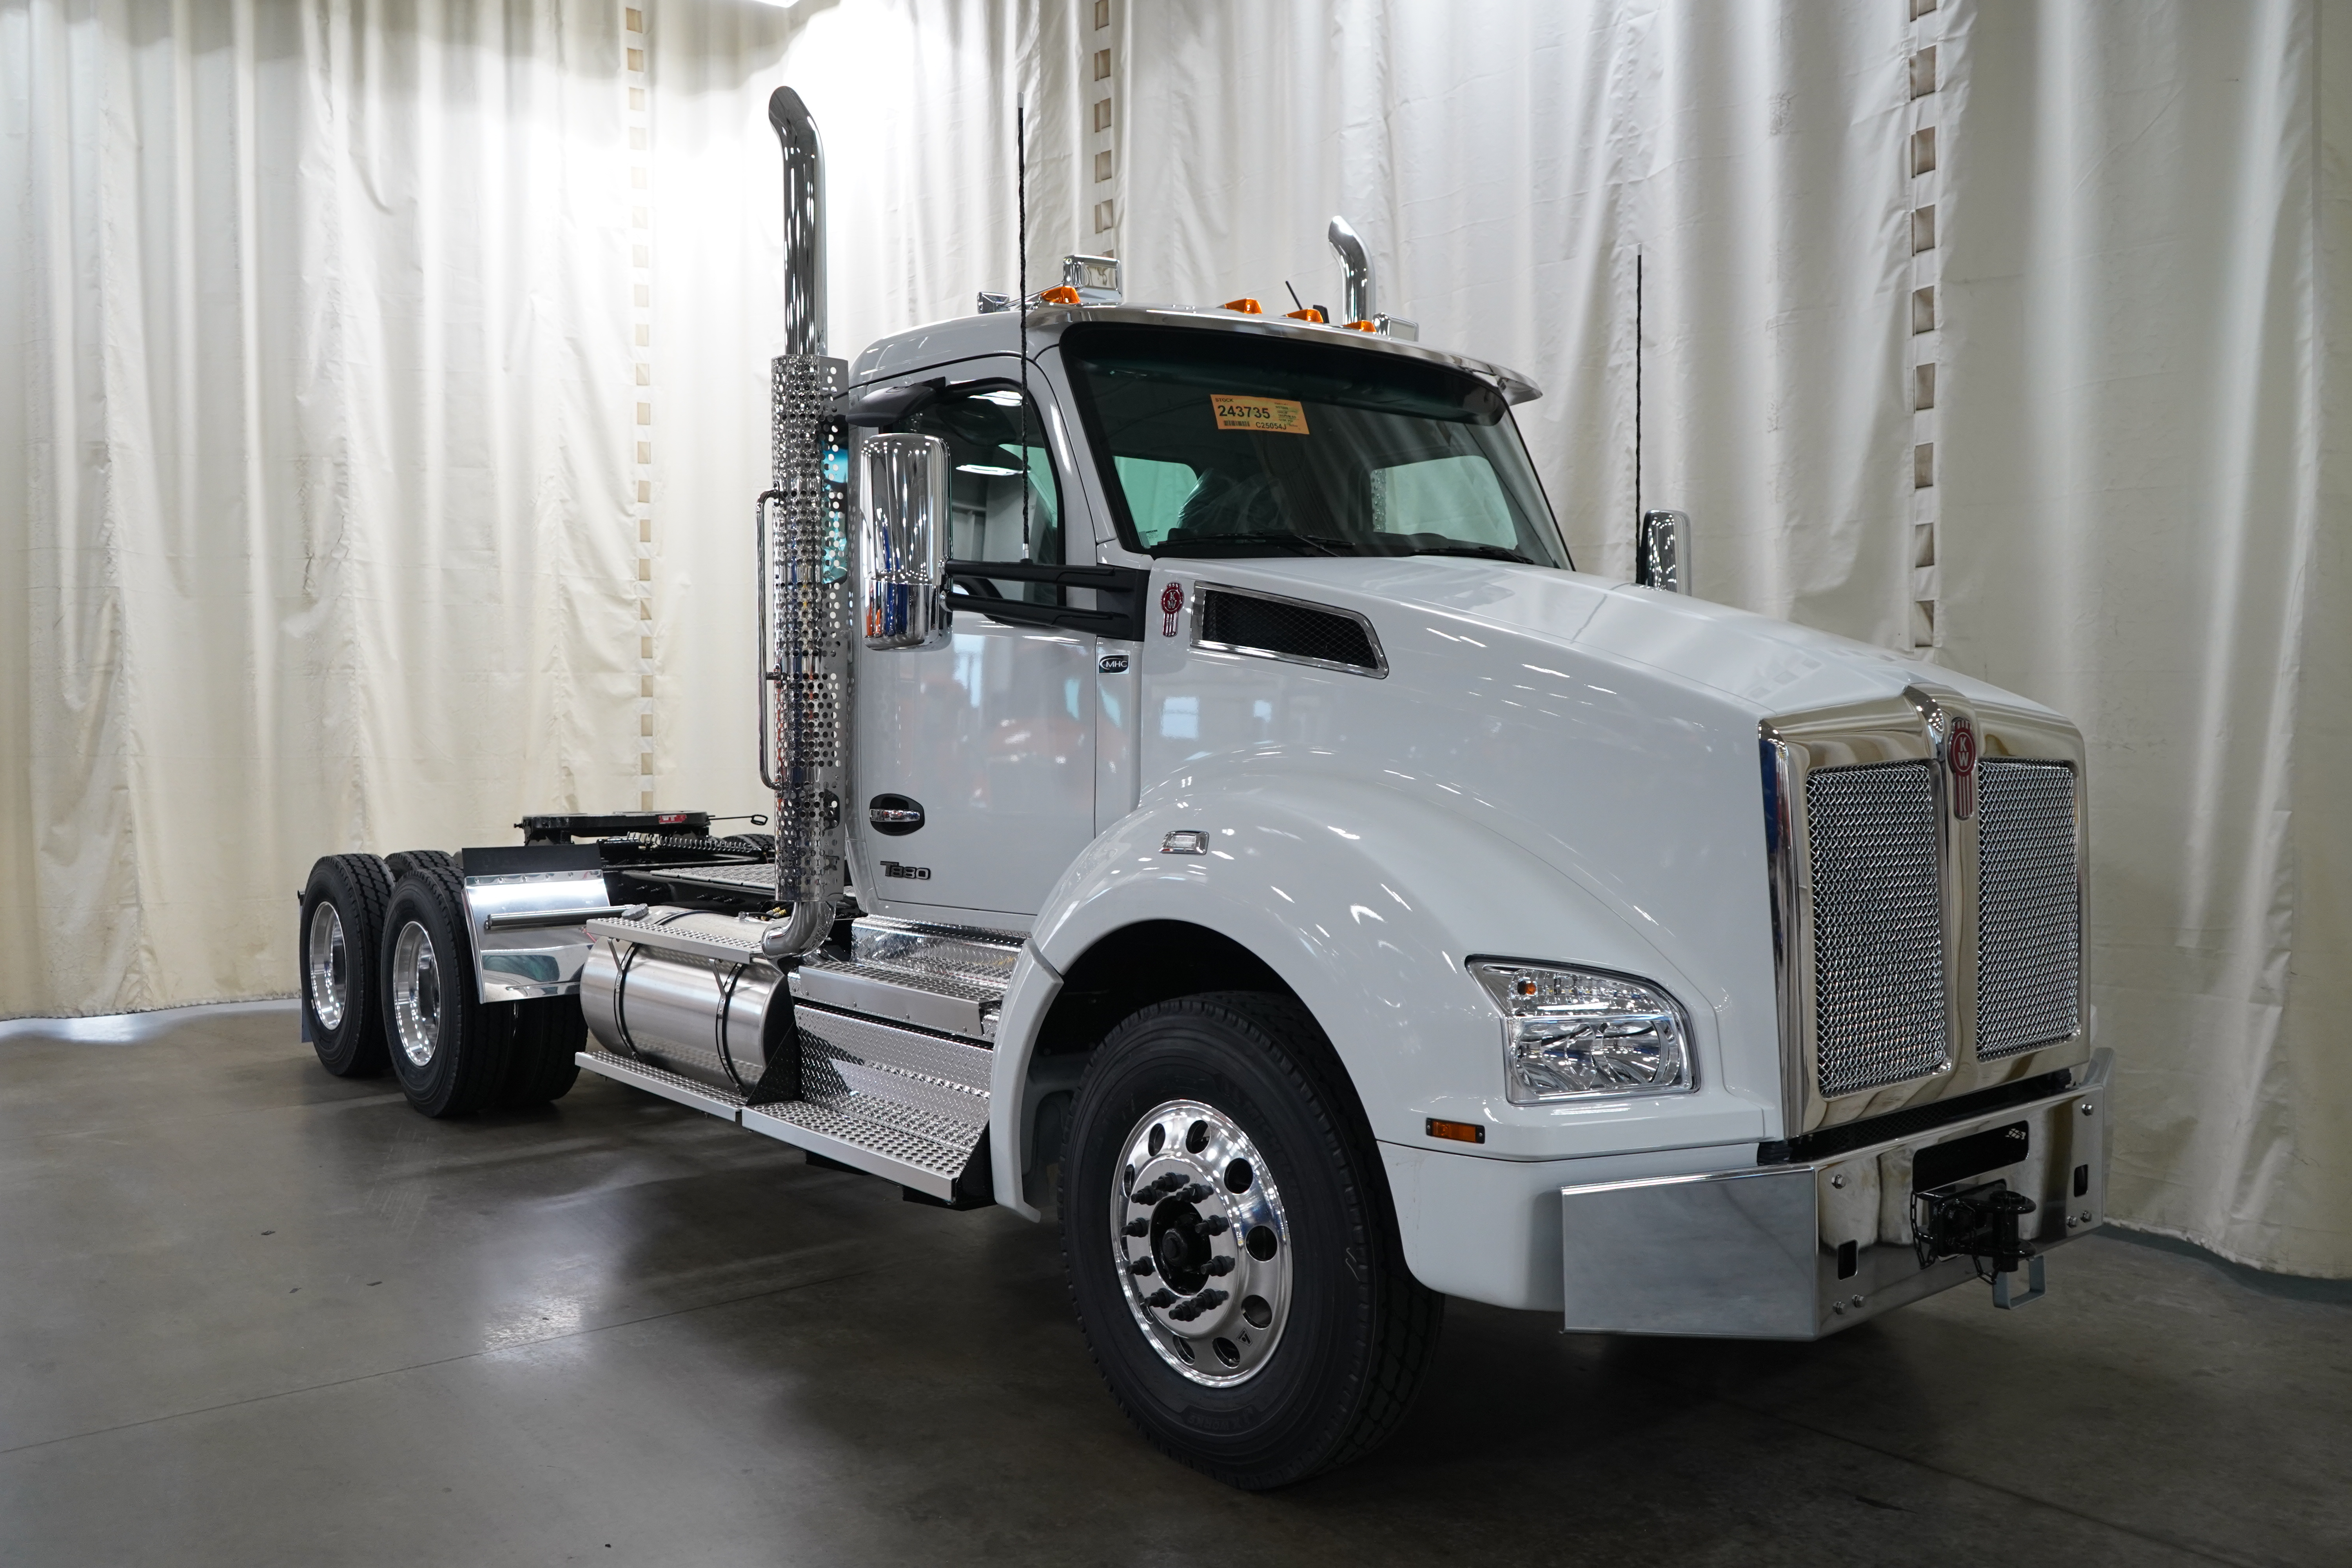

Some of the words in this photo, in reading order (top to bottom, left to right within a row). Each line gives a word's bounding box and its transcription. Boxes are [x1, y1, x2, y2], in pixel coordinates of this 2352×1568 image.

[1218, 405, 1270, 419] 243735
[1256, 422, 1287, 430] C25054J
[1960, 737, 1967, 751] K
[1958, 751, 1969, 766] W
[880, 861, 931, 880] T880
